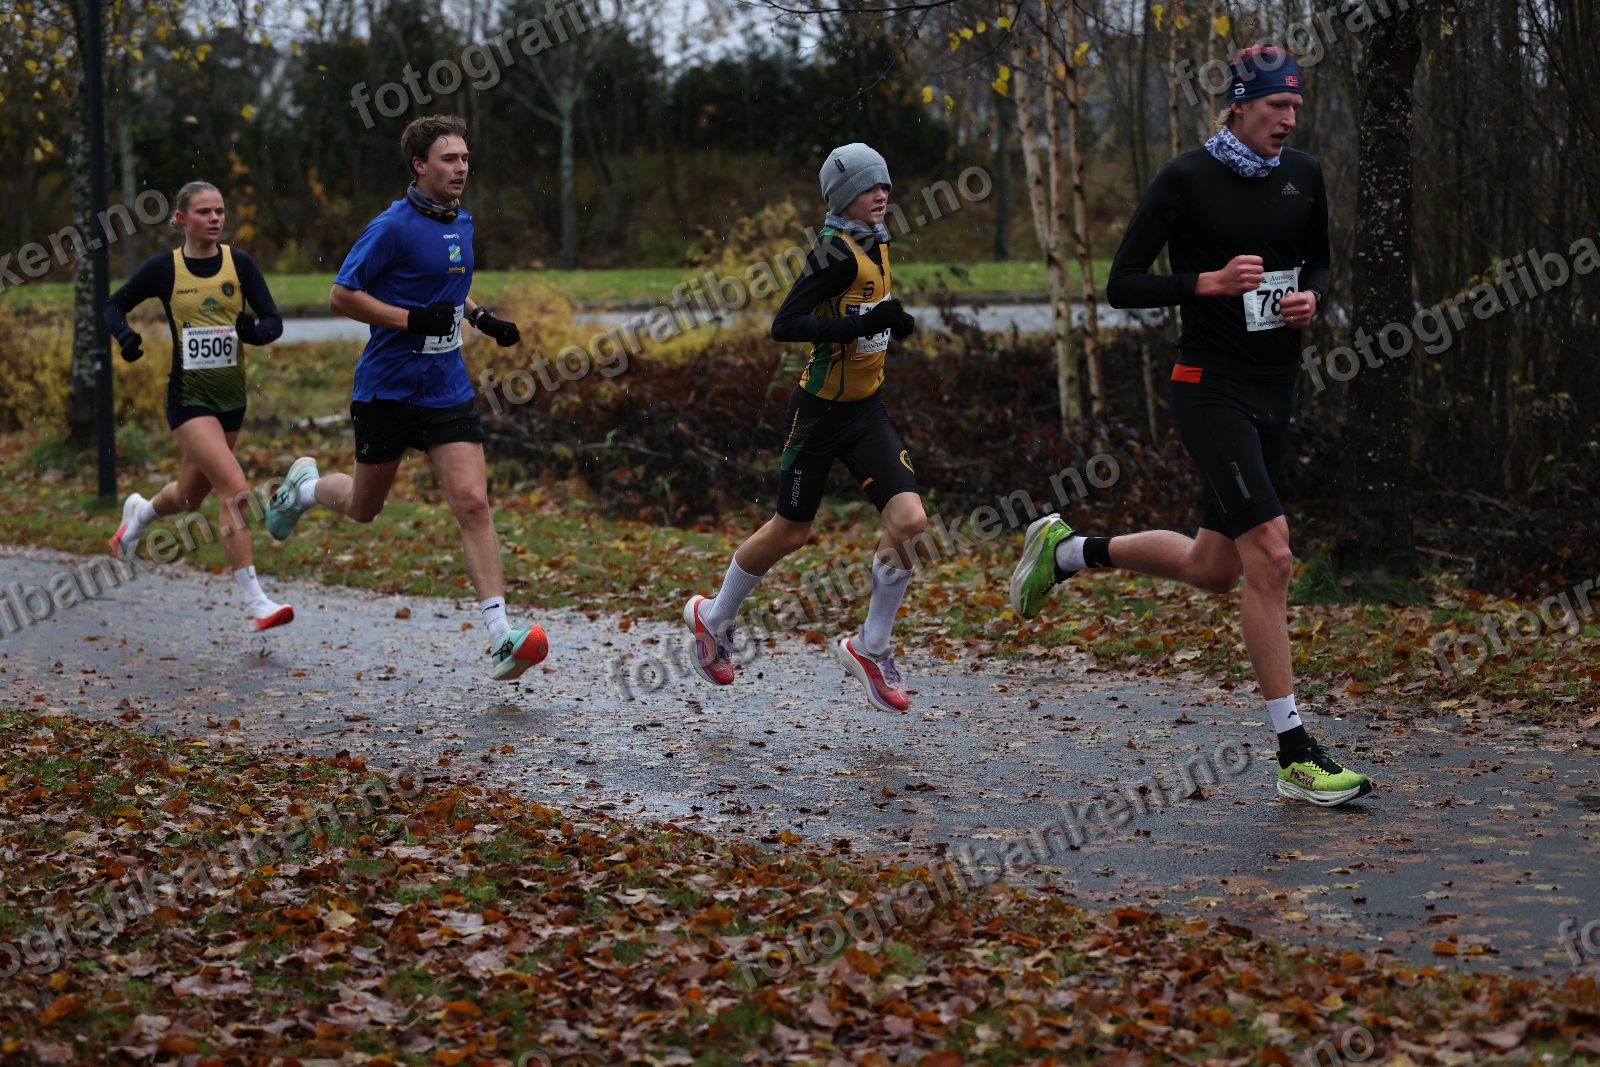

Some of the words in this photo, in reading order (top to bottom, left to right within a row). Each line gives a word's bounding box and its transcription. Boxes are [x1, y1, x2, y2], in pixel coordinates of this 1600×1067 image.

[1270, 273, 1294, 282] Aurskog
[1257, 286, 1295, 318] 78
[188, 337, 232, 358] 9506
